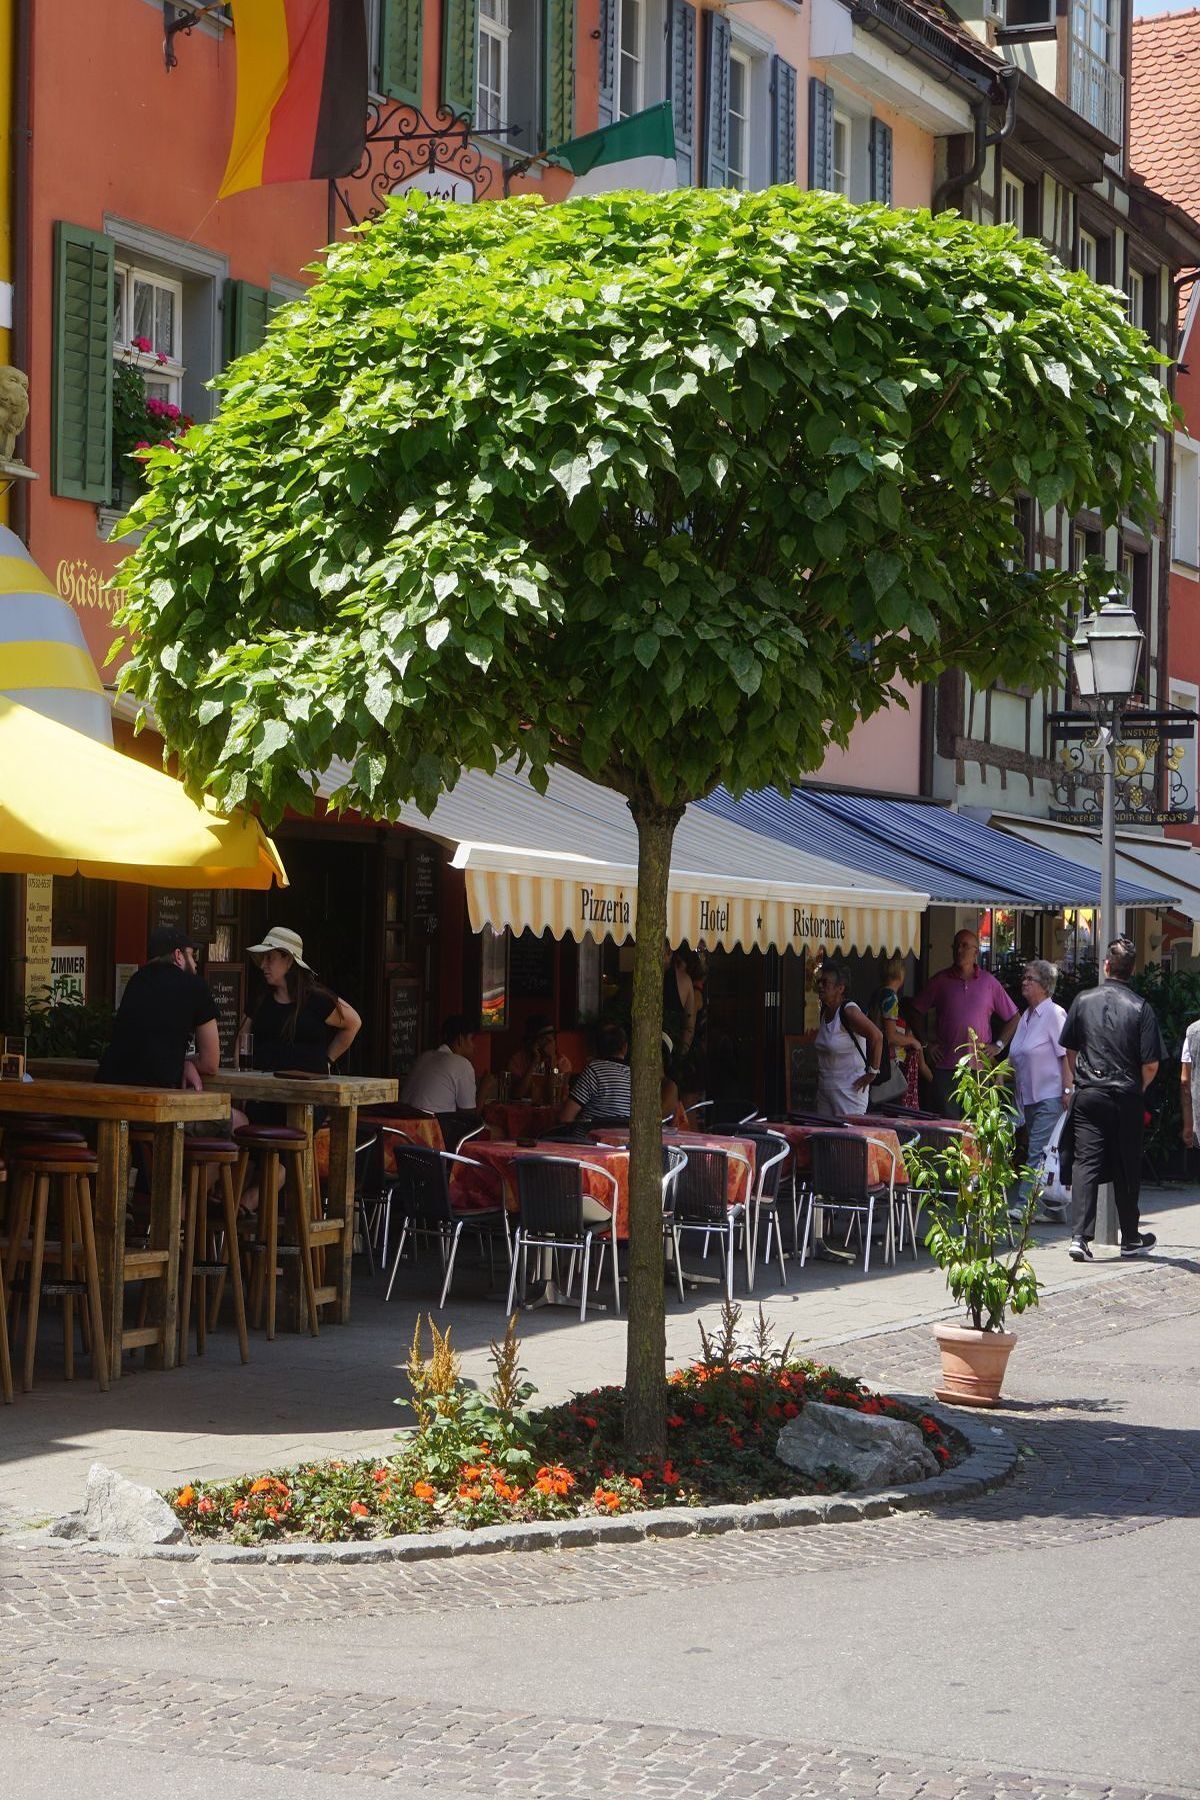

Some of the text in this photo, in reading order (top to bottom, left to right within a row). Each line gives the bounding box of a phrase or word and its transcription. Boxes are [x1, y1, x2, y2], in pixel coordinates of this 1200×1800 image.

[581, 889, 845, 939] Pizzeria Hotel Ristorante
[51, 957, 85, 973] ZIMMER
